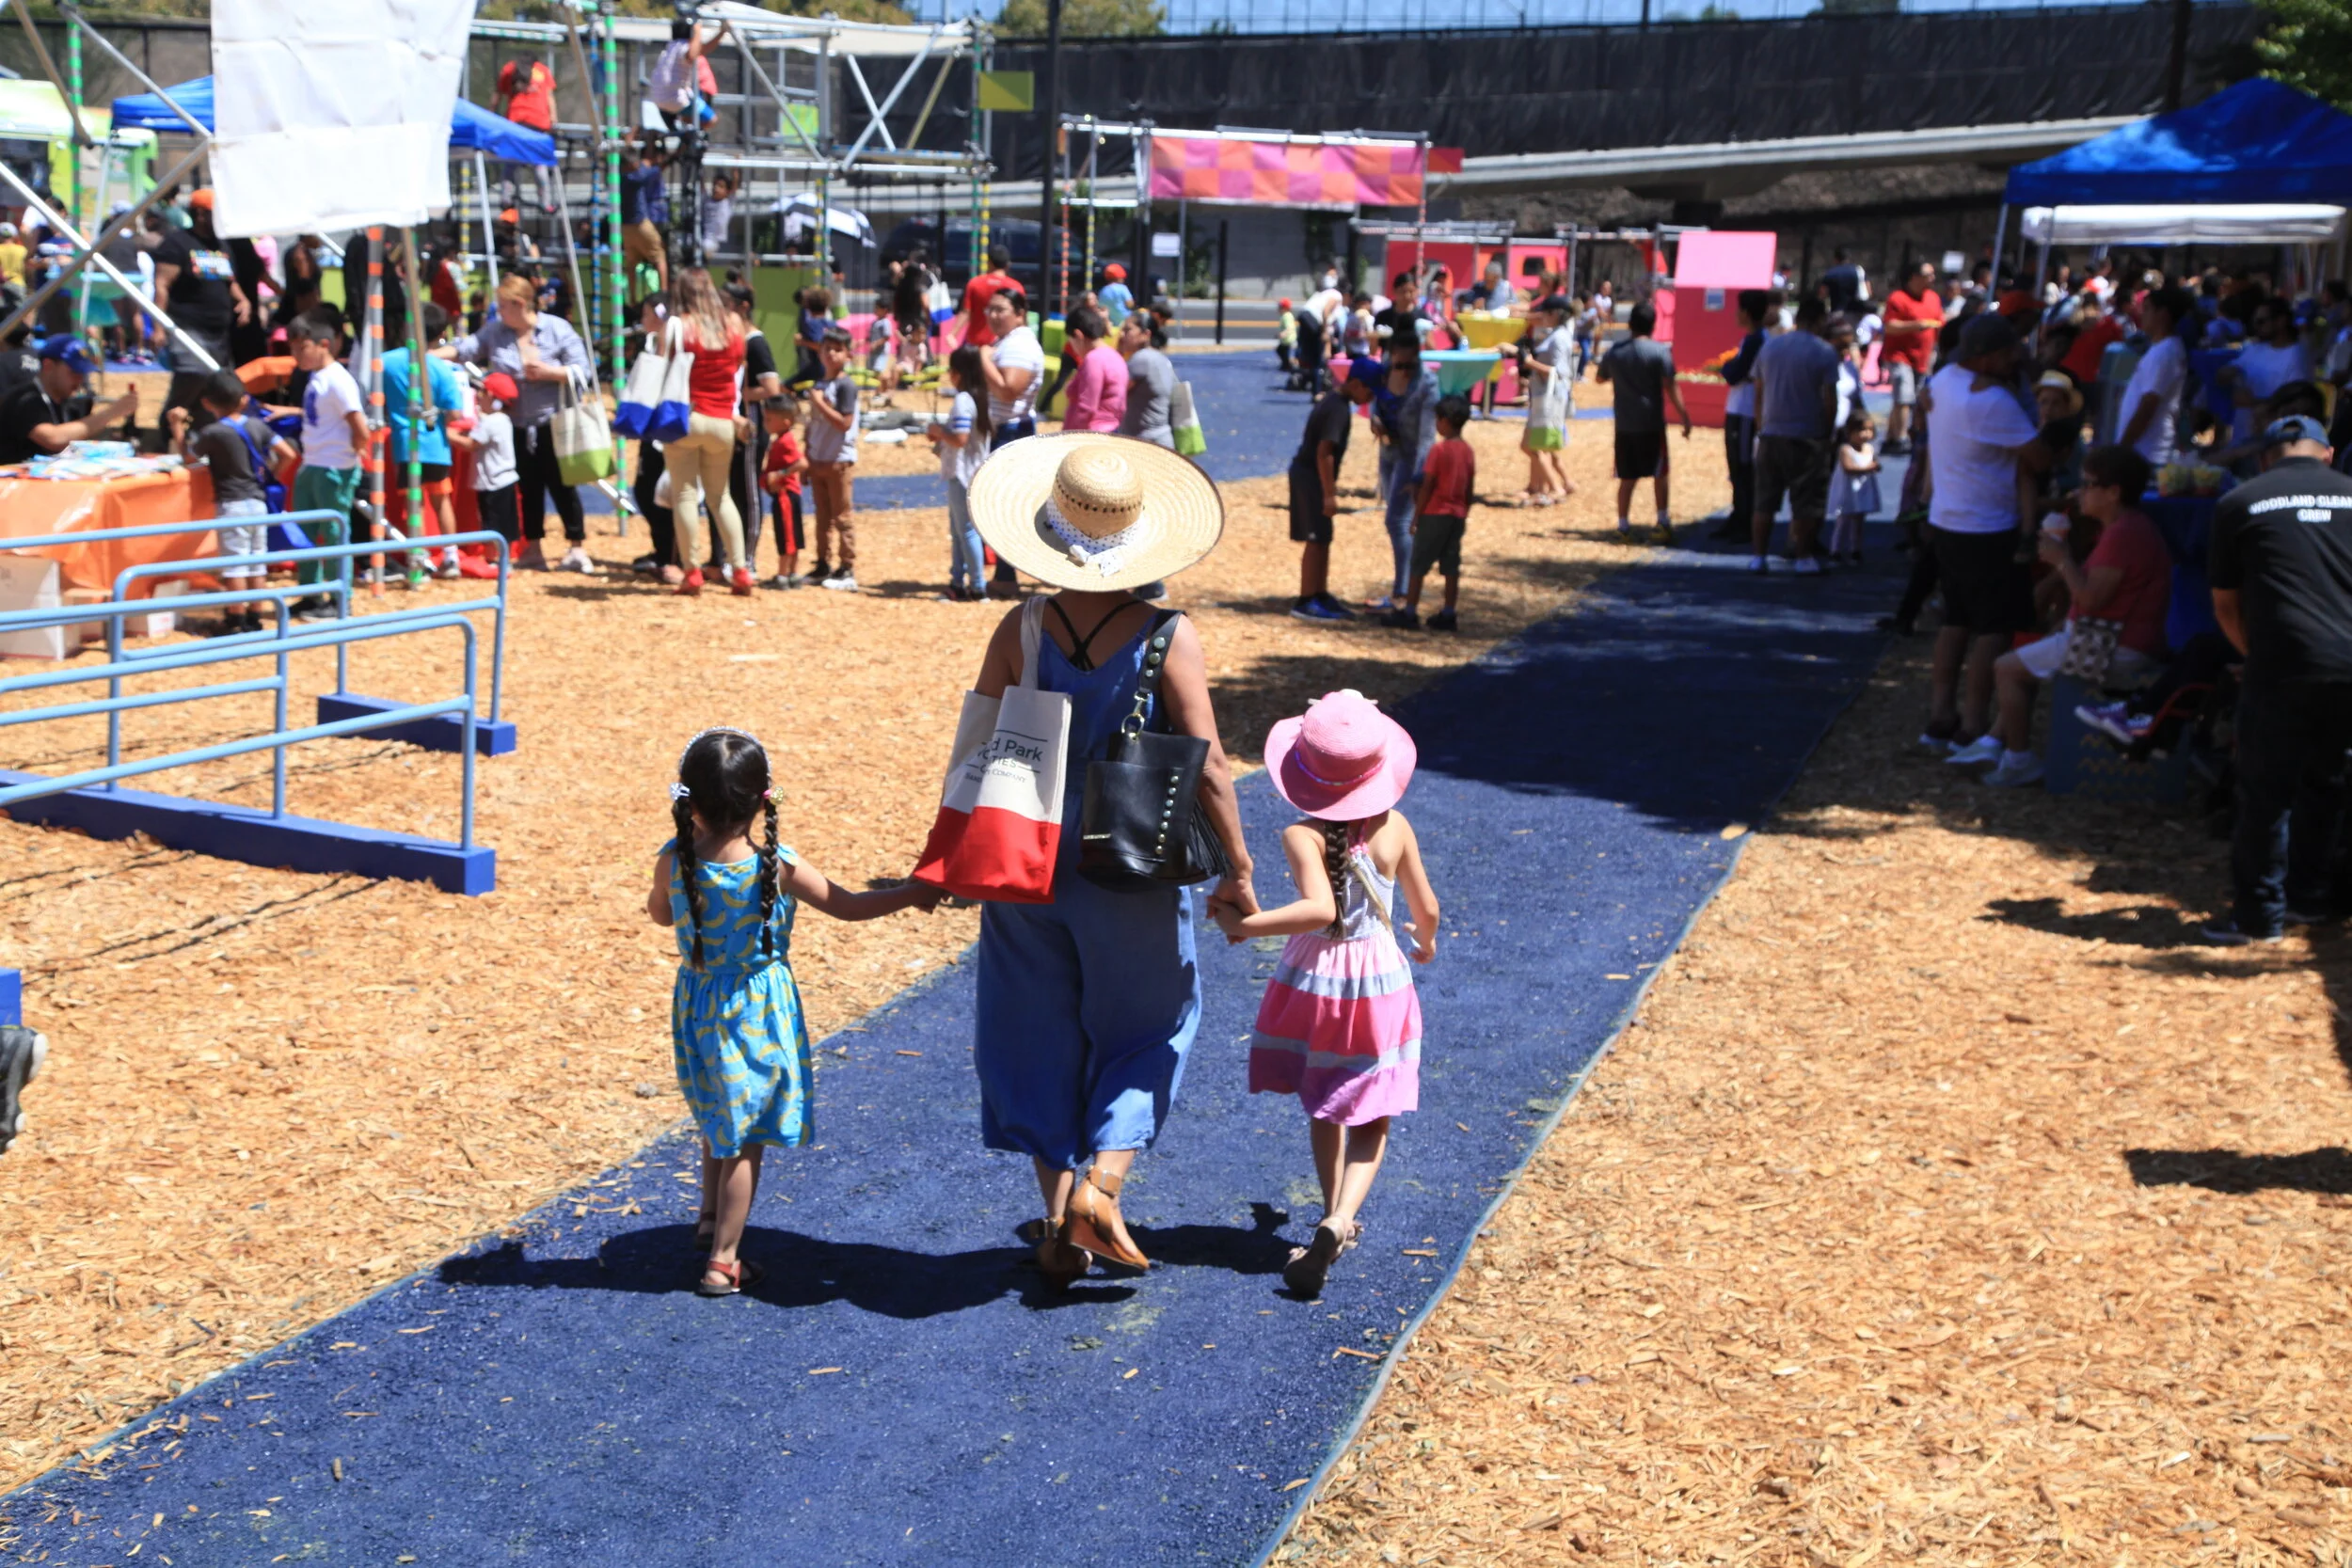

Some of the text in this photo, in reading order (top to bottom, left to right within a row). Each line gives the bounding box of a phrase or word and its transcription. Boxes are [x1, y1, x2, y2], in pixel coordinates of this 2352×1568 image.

[2249, 495, 2315, 515] WOODLAND
[2296, 509, 2331, 523] CREW
[1004, 739, 1043, 762] Park
